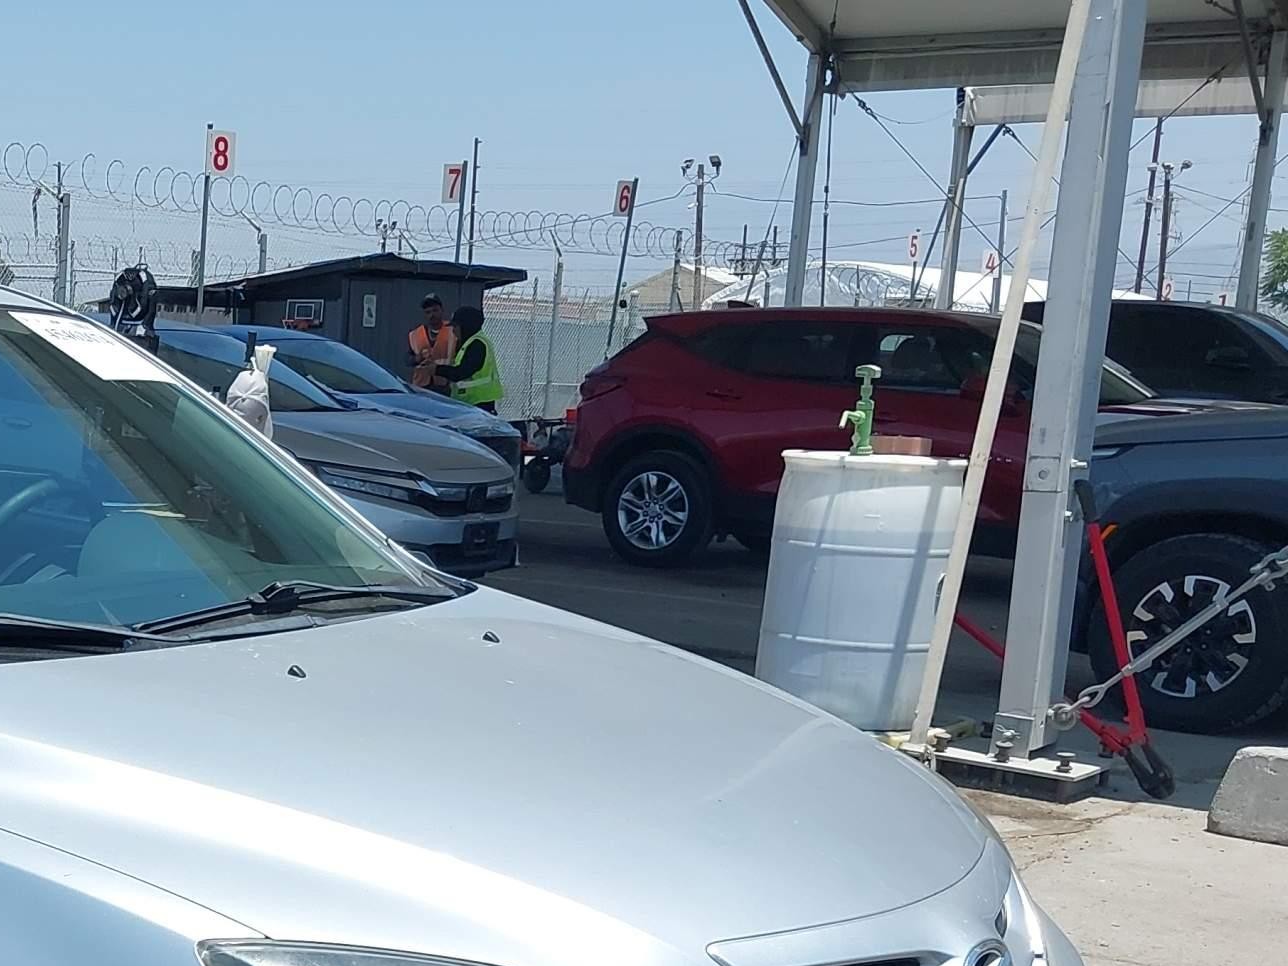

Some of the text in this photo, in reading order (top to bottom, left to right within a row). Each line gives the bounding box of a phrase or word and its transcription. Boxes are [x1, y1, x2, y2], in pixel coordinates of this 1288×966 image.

[213, 136, 229, 171] 8
[448, 168, 462, 199] 7
[619, 184, 631, 213] 6
[909, 235, 918, 258] 5
[985, 252, 996, 273] 4
